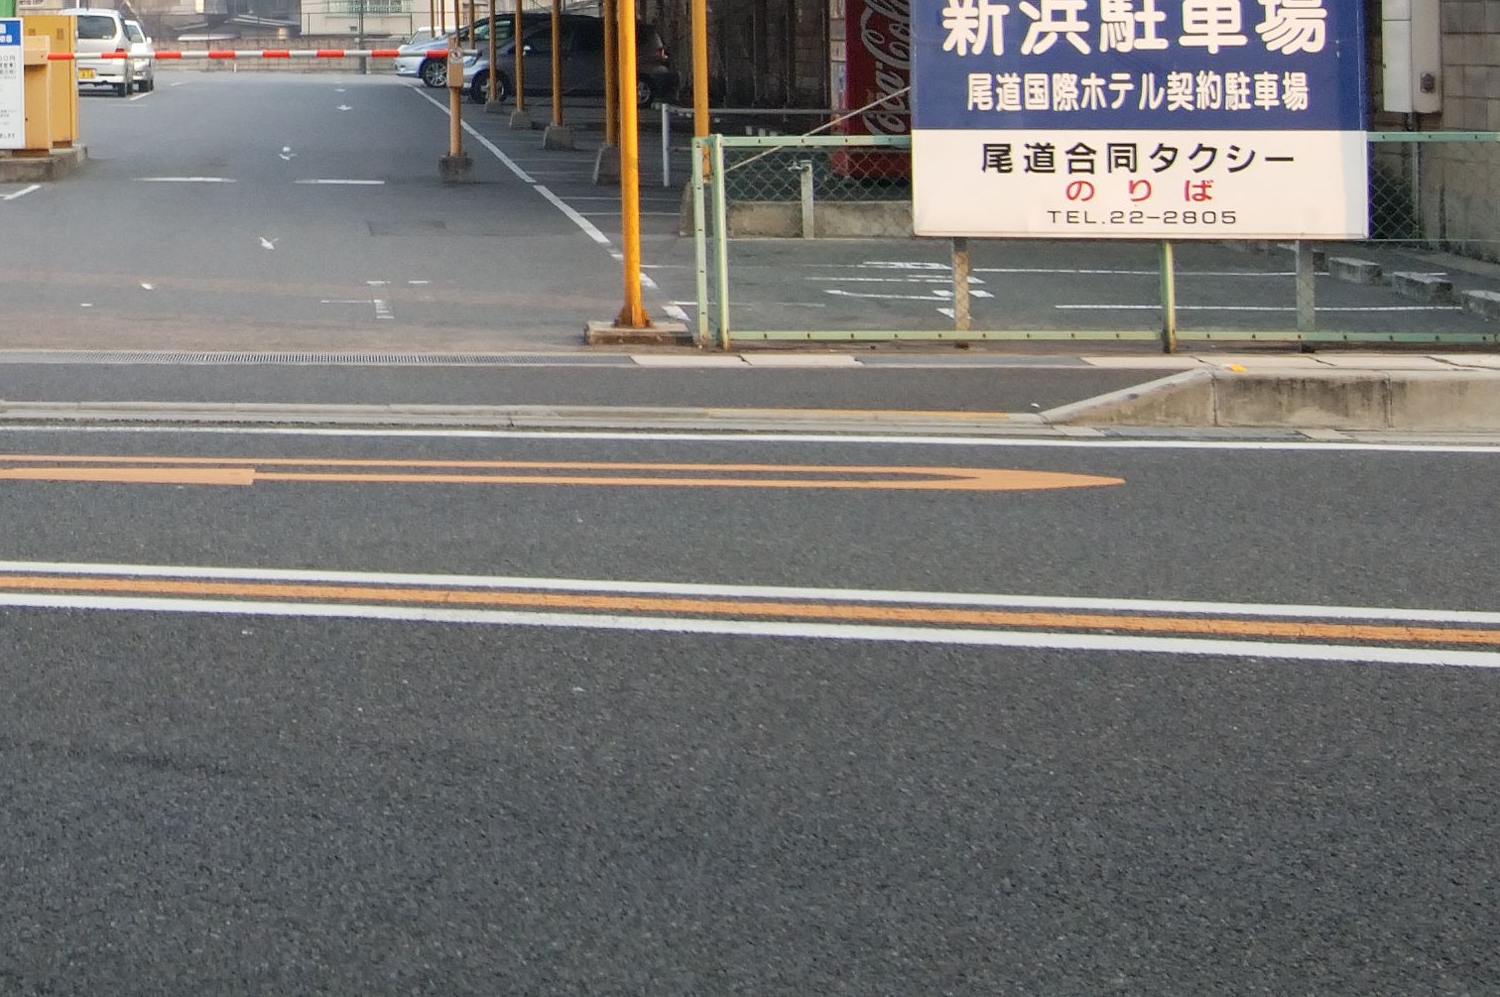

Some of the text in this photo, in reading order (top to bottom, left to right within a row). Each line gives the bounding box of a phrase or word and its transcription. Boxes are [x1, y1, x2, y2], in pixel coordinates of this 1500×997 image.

[965, 70, 1310, 113] 尾道国際ホテル契約駐車場
[980, 142, 1295, 176] 尾道合同タクシー
[1065, 179, 1215, 203] のりば
[1047, 210, 1238, 226] TEL.22-2805
